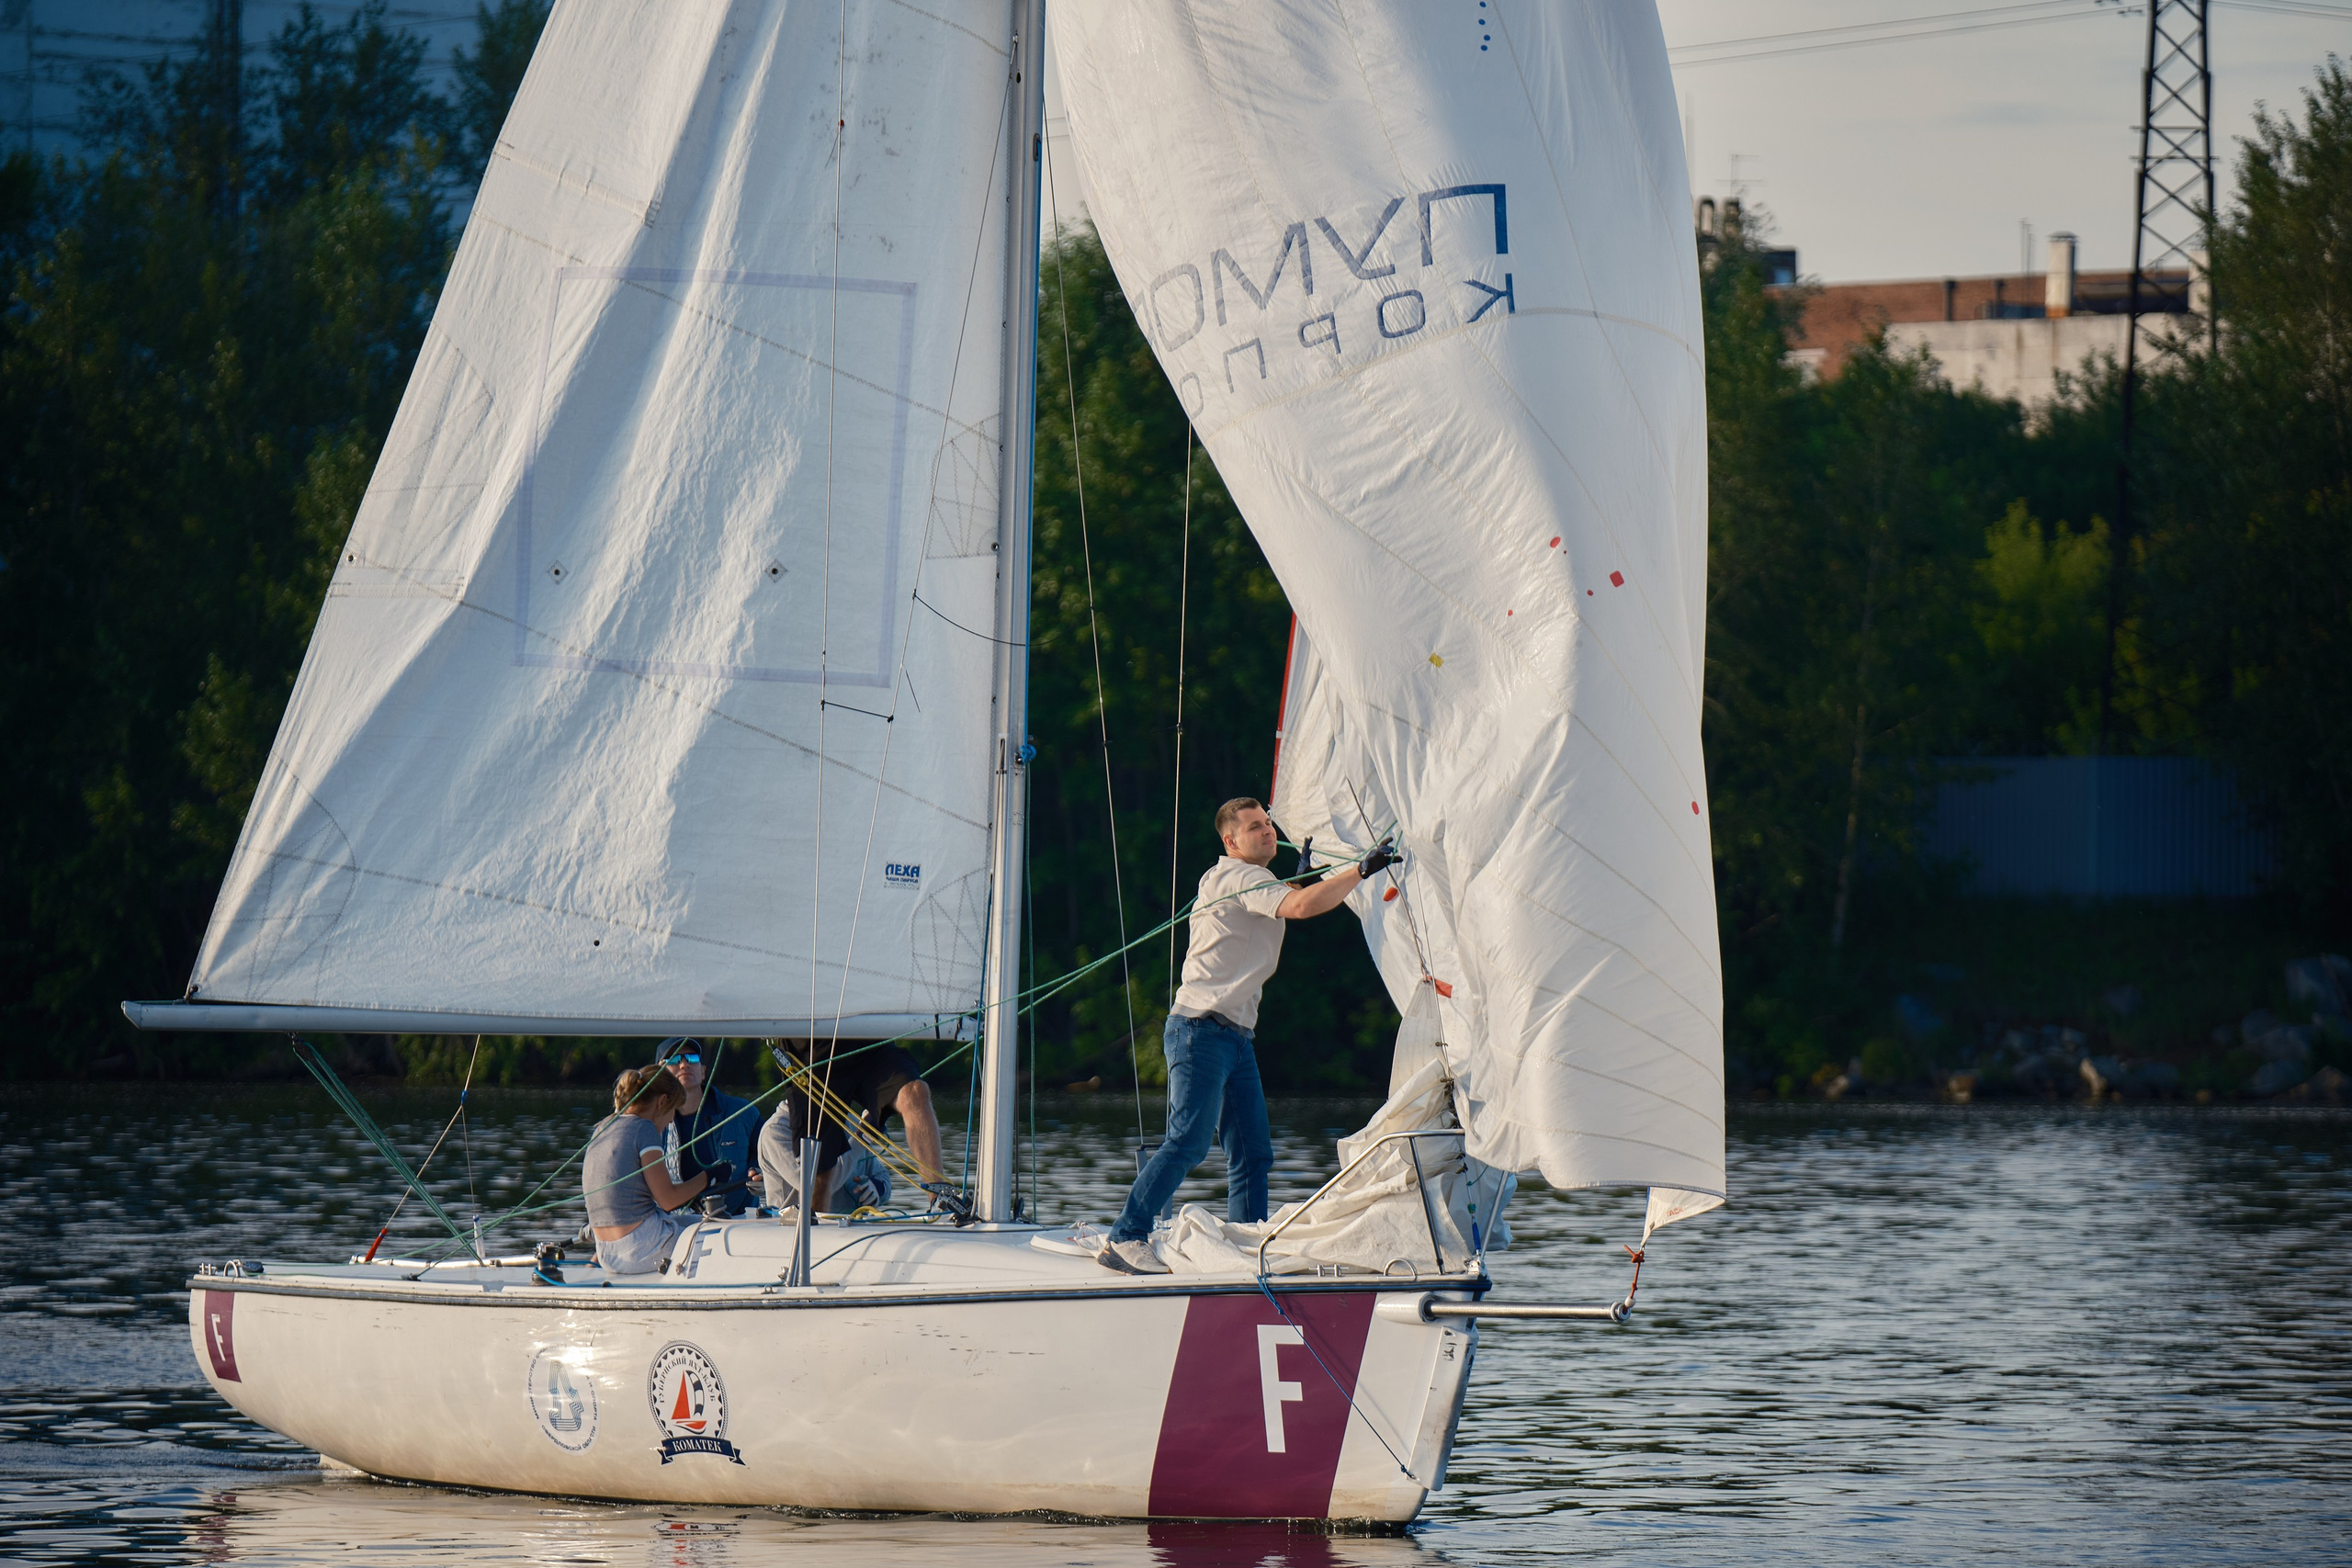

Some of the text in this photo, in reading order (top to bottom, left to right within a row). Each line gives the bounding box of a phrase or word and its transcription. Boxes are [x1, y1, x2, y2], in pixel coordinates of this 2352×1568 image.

[687, 1227, 723, 1279] F
[211, 1314, 226, 1361] F
[658, 1355, 716, 1404] ГУБЕРНСКИЙ ЯХТ-КЛУБ
[1256, 1324, 1305, 1453] F
[672, 1439, 722, 1452] КОМАТЕК
